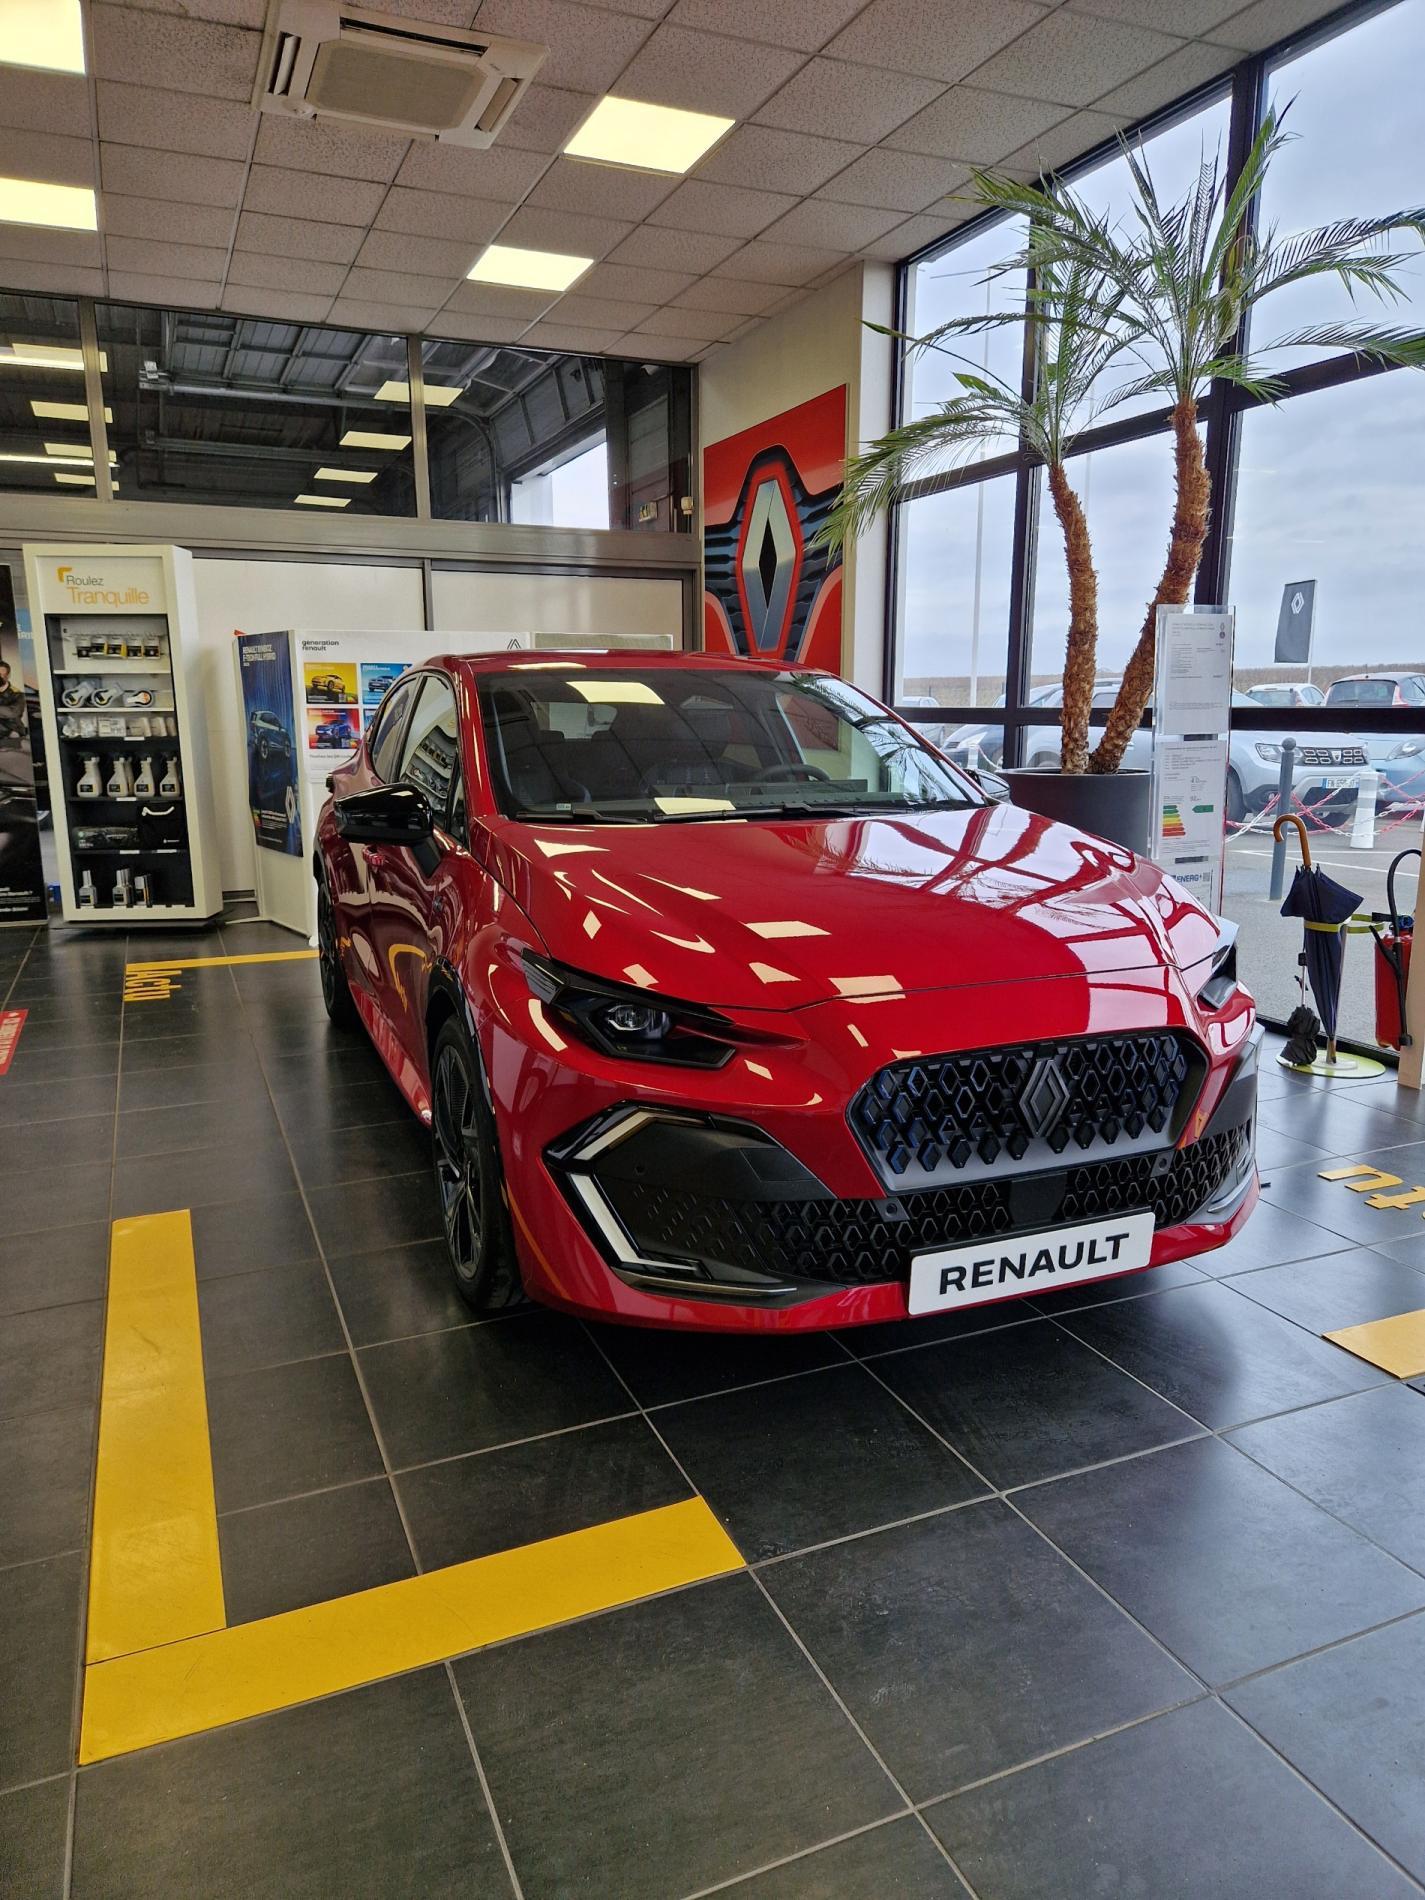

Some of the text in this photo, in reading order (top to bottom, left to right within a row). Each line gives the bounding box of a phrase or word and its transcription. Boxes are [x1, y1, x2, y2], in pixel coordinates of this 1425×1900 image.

[66, 575, 104, 586] Roulez
[66, 586, 150, 608] Tranquille
[939, 1232, 1130, 1295] RENAULT
